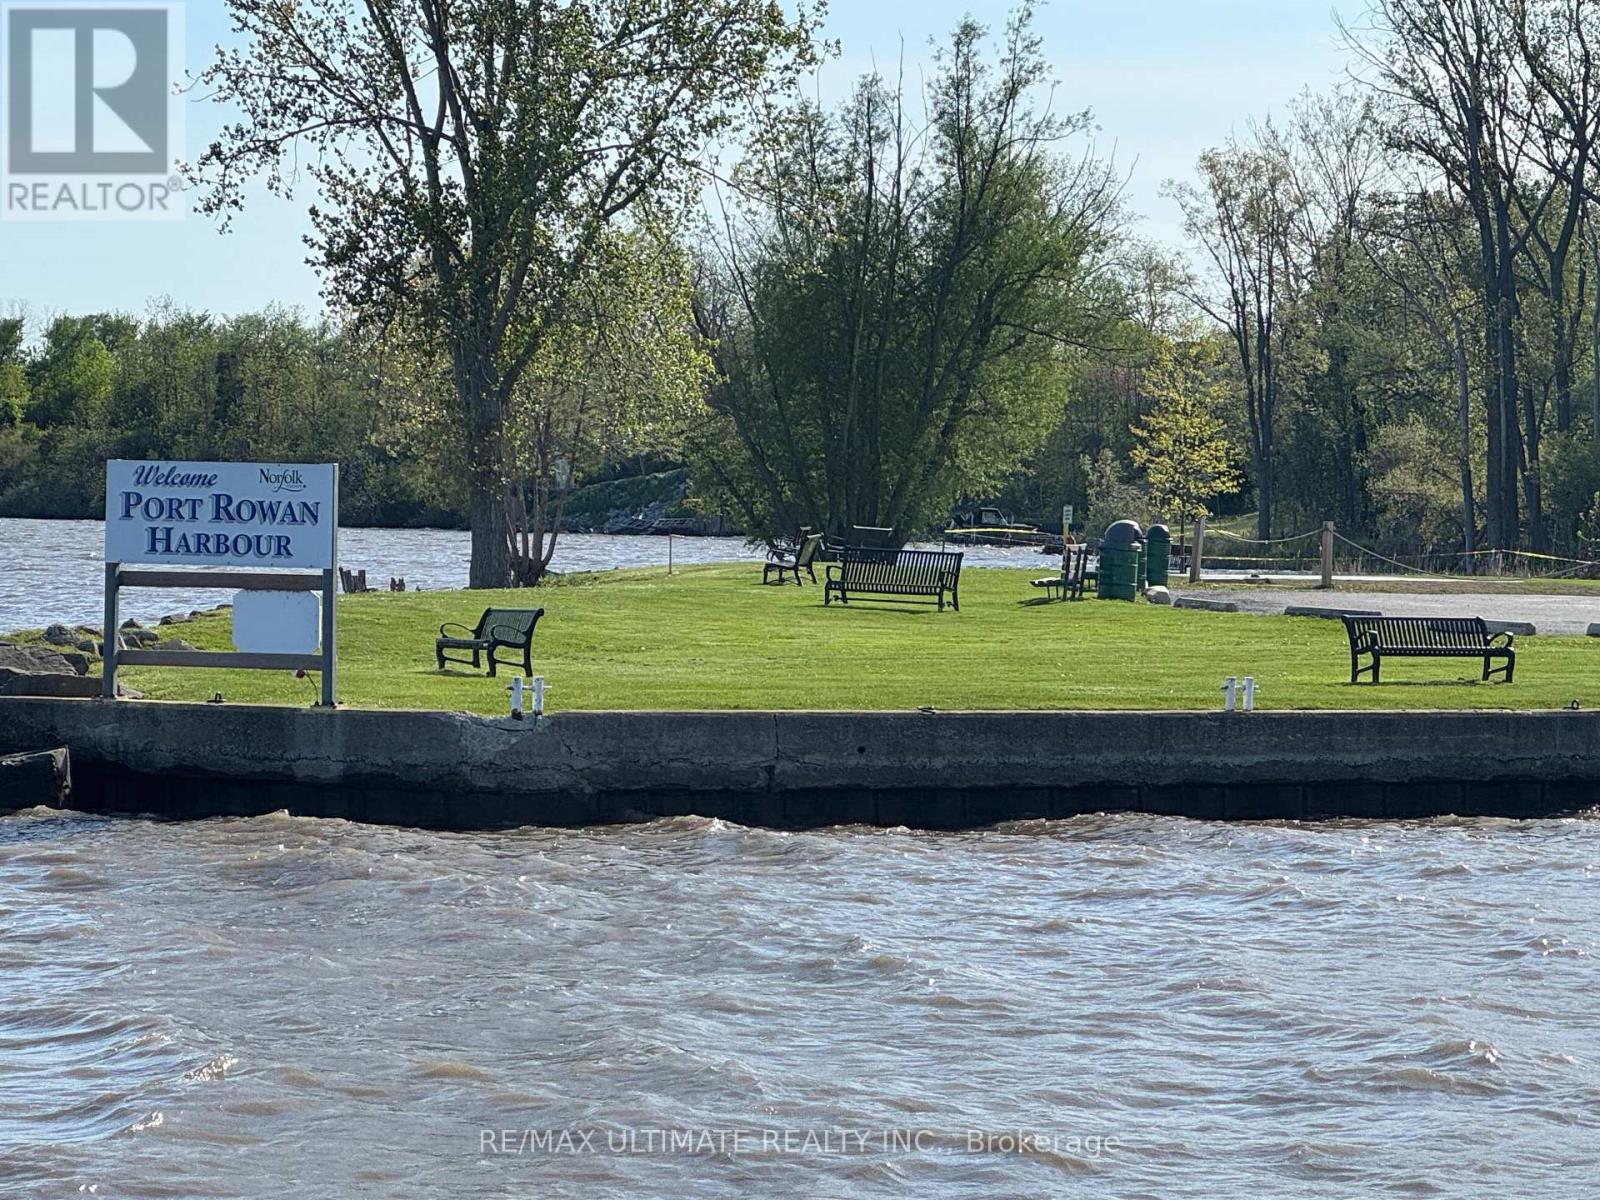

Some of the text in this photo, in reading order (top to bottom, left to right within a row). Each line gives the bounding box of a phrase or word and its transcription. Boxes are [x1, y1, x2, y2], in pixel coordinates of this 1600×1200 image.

[133, 465, 218, 488] Welcome
[259, 468, 304, 492] Norfolk
[119, 491, 320, 525] PORT ROWAN
[145, 526, 293, 558] HARBOUR
